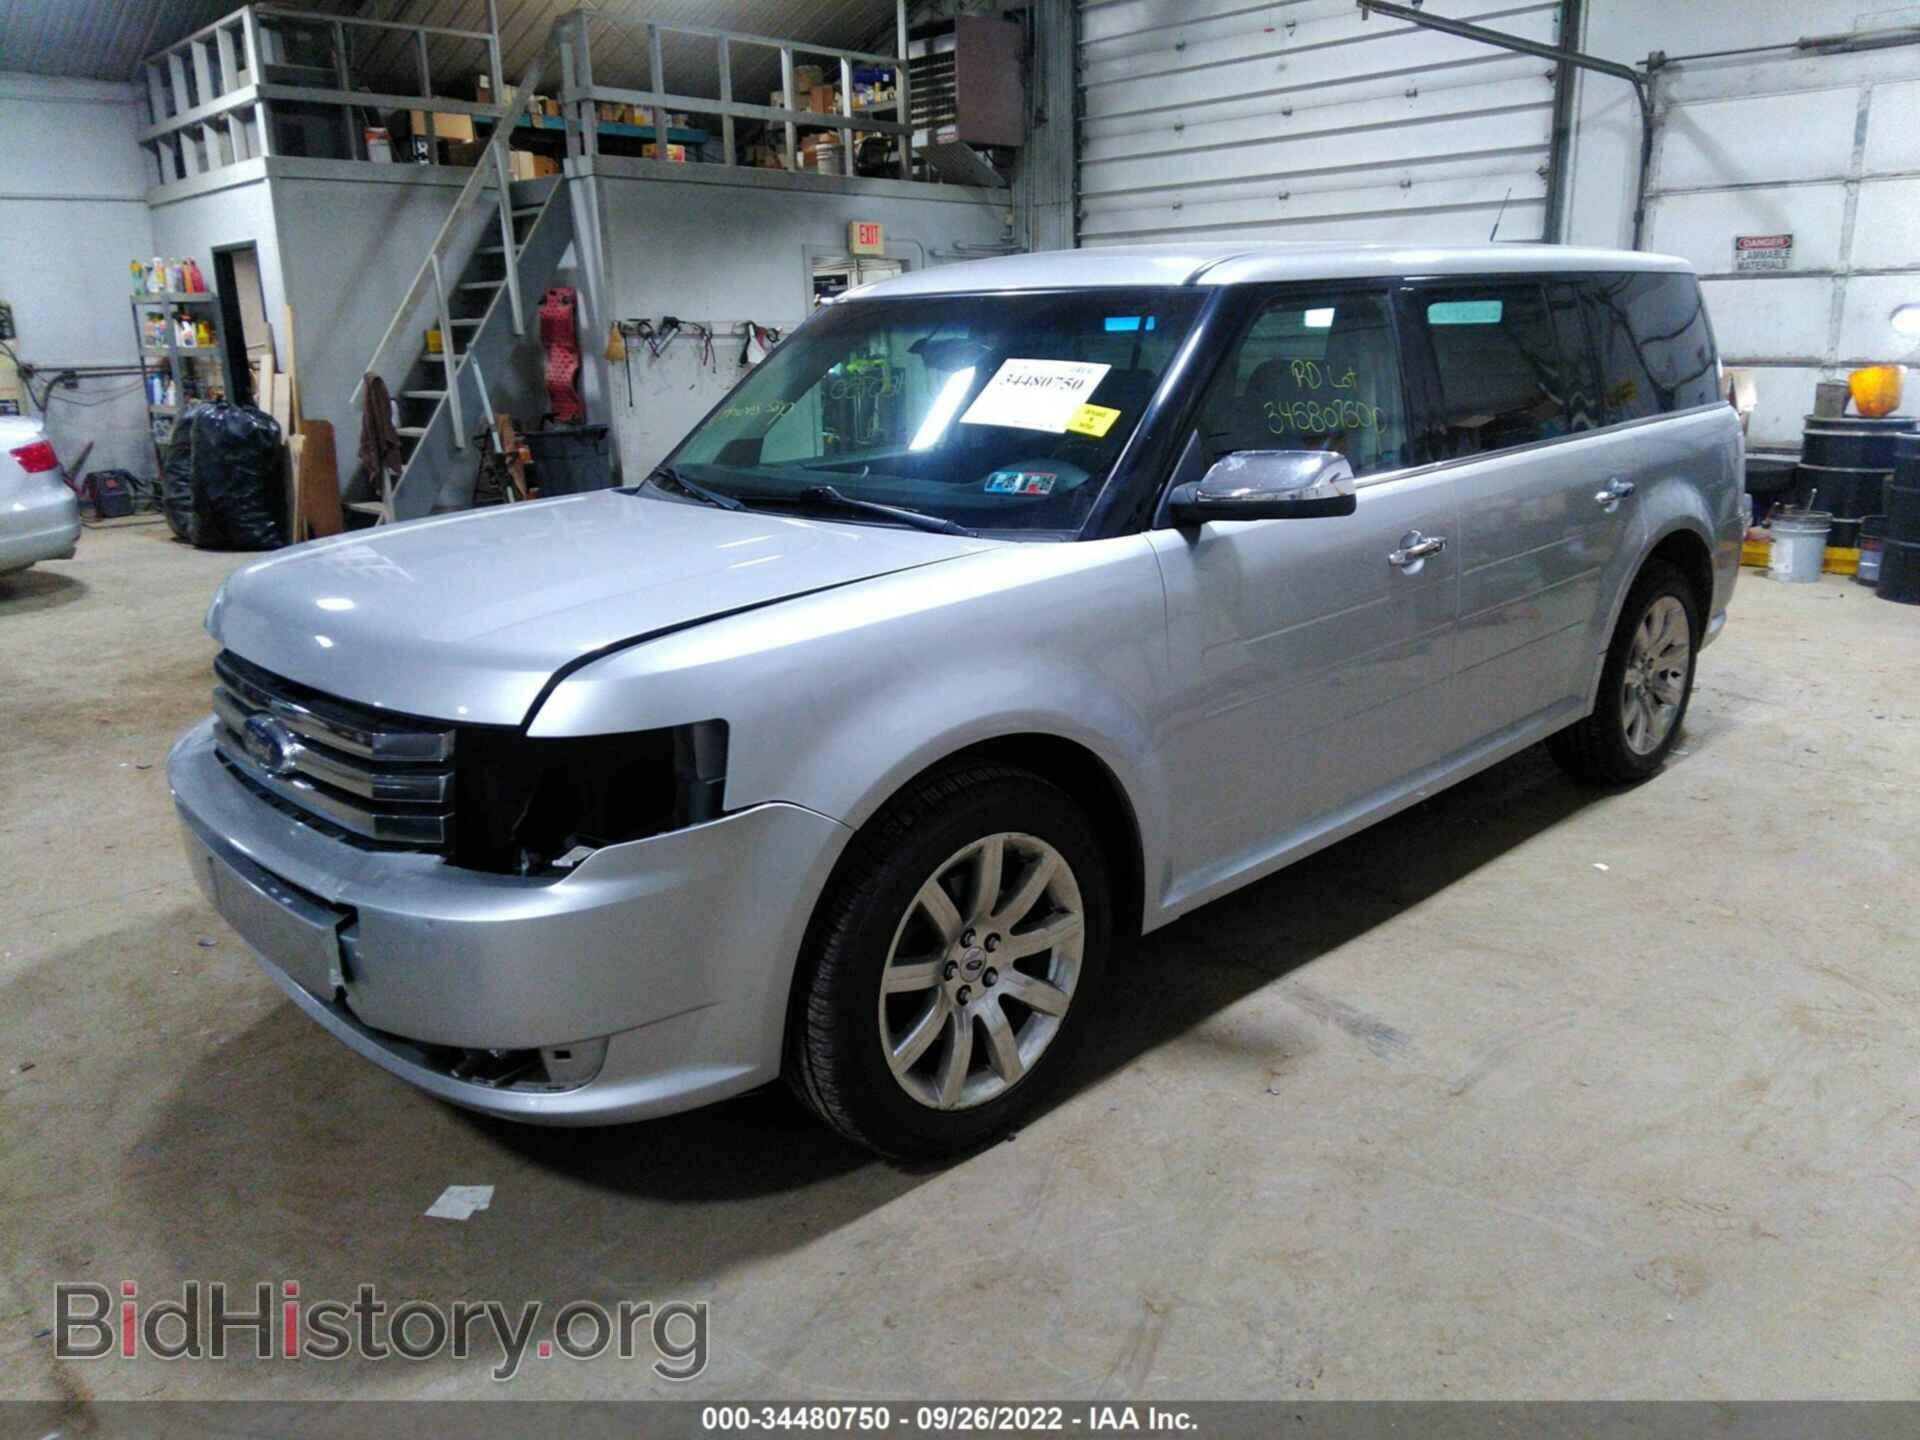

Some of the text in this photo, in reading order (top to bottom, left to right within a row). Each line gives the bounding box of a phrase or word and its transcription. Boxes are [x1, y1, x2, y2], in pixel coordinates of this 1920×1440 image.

[859, 224, 879, 245] EXIT
[1742, 237, 1785, 248] DANGER
[1735, 248, 1792, 260] FLAMMABLE
[1737, 259, 1788, 271] MATERIALS
